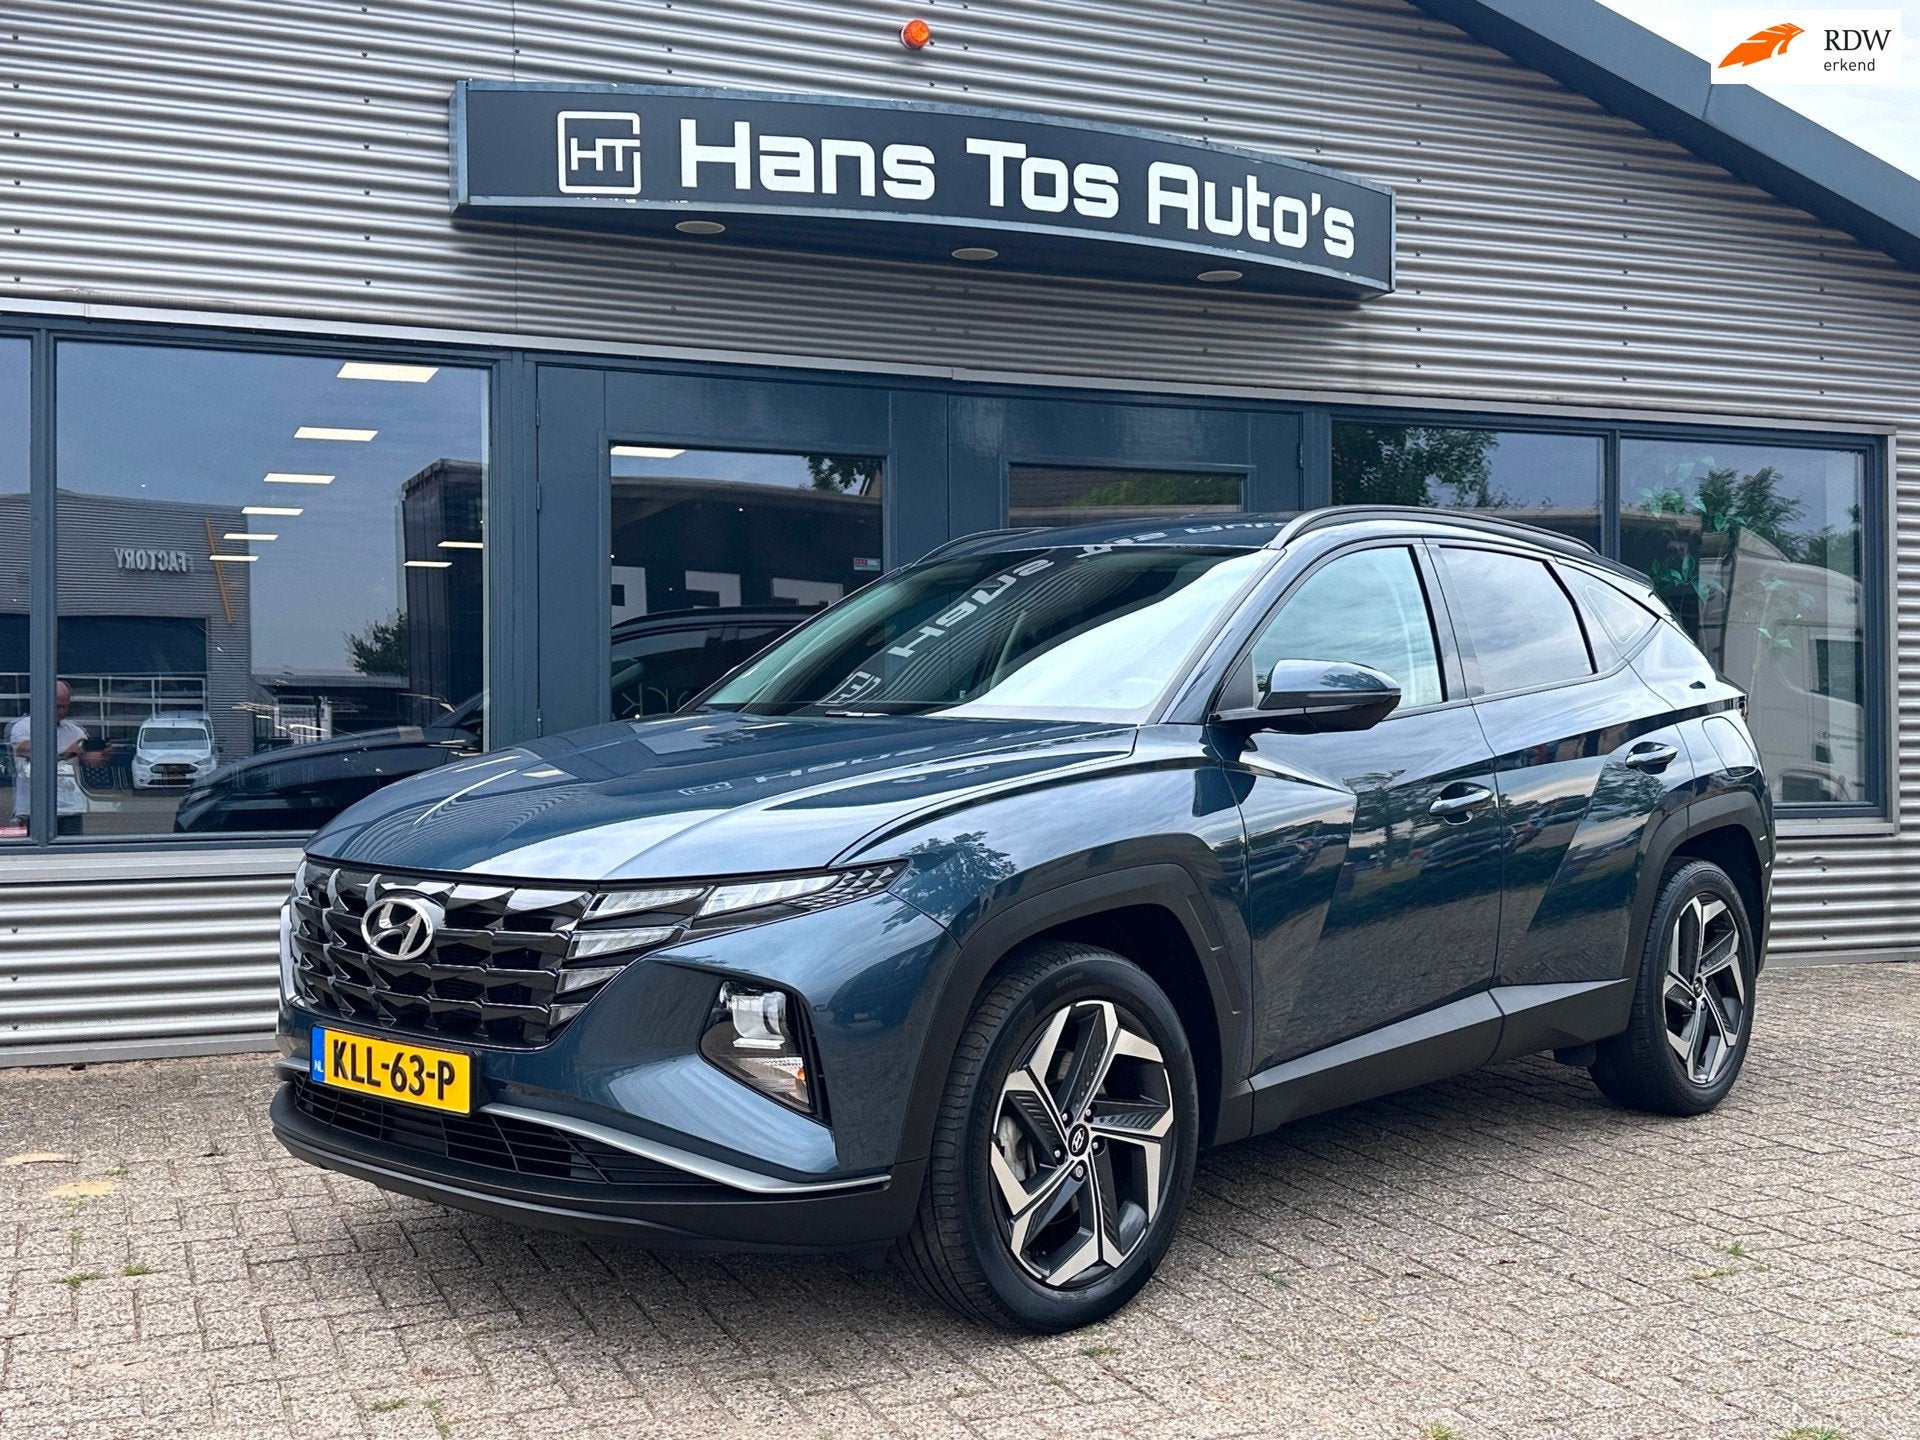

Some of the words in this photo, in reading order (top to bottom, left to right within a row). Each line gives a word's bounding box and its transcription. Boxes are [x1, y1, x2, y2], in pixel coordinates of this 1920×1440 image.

[680, 118, 936, 200] Hans
[965, 137, 1119, 218] Tos
[1148, 161, 1355, 259] Auto's
[314, 1059, 324, 1073] NL
[333, 1039, 455, 1101] KLL-63-P
